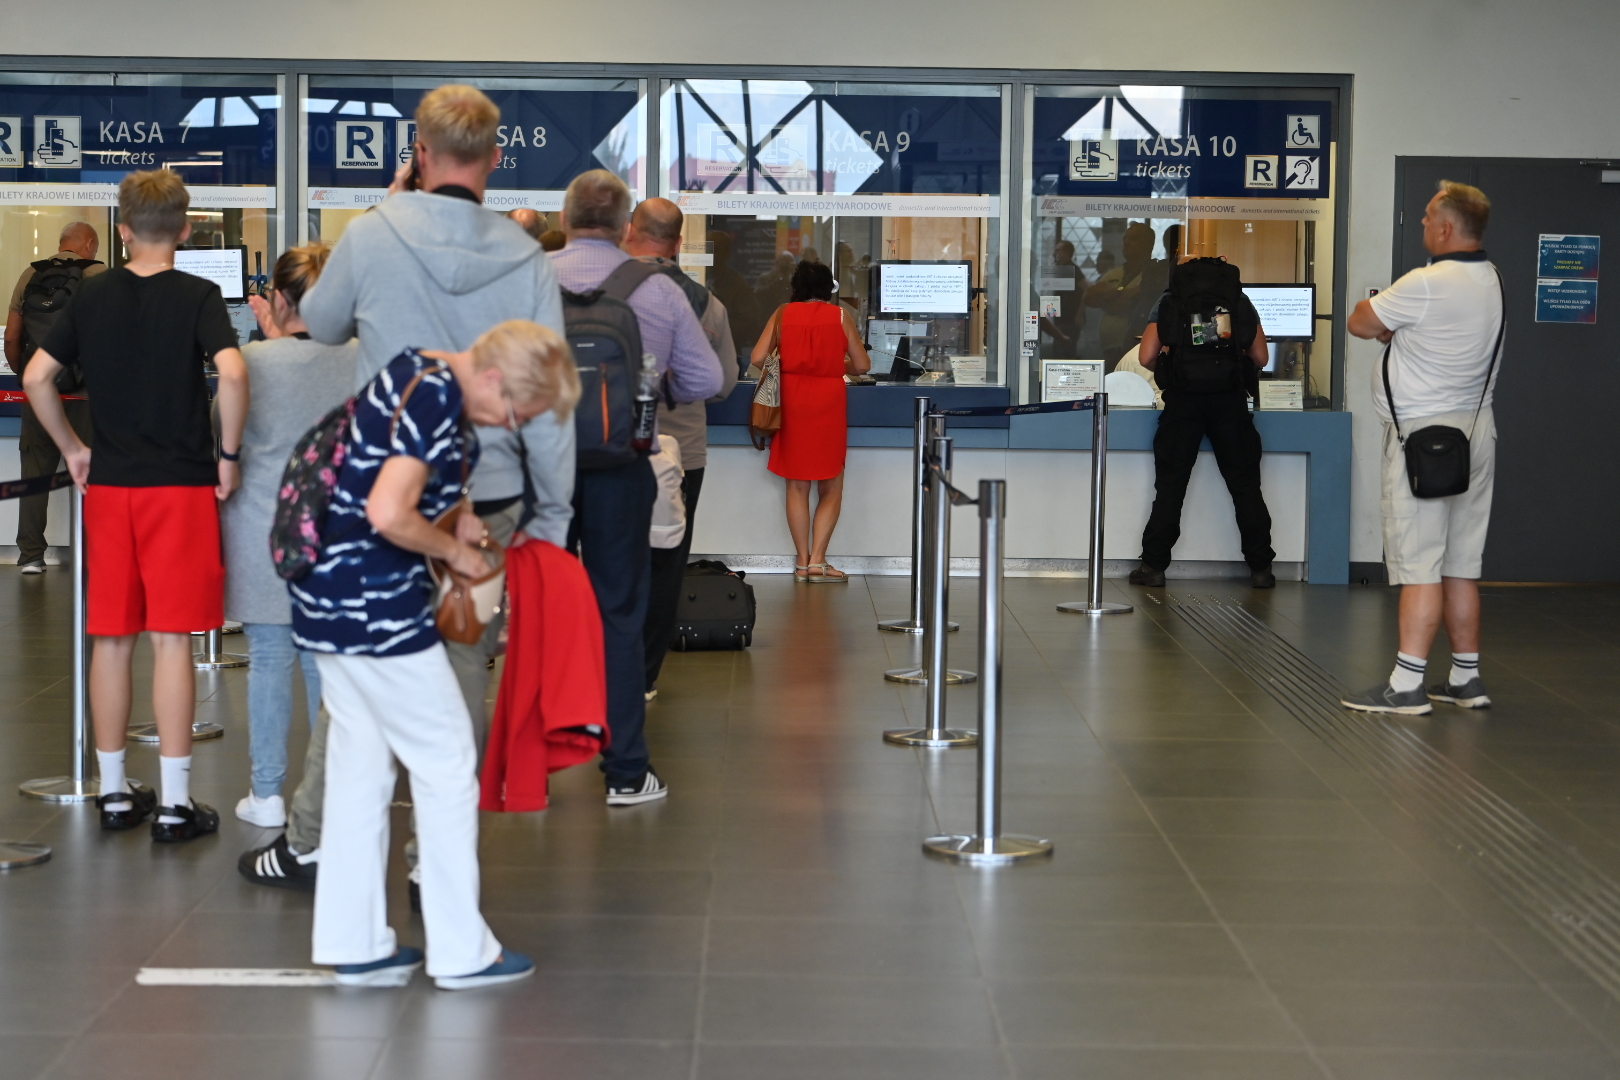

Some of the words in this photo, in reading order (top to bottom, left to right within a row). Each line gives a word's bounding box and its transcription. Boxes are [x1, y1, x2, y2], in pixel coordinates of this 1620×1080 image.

[100, 121, 164, 144] KASA
[179, 121, 192, 144] 7
[495, 125, 527, 148] SA
[532, 126, 547, 148] 8
[346, 125, 377, 160] R
[710, 130, 739, 164] R
[825, 130, 890, 153] KASA
[896, 131, 911, 153] 9
[1136, 134, 1201, 157] KASA
[1209, 135, 1237, 157] 10
[100, 149, 156, 165] tickets
[825, 158, 881, 174] tickets
[1136, 161, 1192, 178] tickets
[1252, 159, 1272, 182] R
[1309, 178, 1315, 186] T
[0, 191, 24, 200] ILETY
[26, 191, 70, 200] KRAJOWE
[72, 191, 75, 200] I
[77, 191, 120, 202] MIĘDZYN
[354, 194, 385, 203] BILETY
[482, 196, 529, 206] ARODOWE
[717, 200, 748, 209] BILETY
[750, 201, 795, 210] KRAJOWE
[796, 201, 799, 210] I
[801, 201, 892, 212] MIĘDZYNARODOWE
[1085, 203, 1112, 211] BILETY
[1113, 203, 1152, 212] KRAJOWE
[1153, 204, 1156, 212] I
[1157, 204, 1236, 214] MIĘDZYNARODOWE
